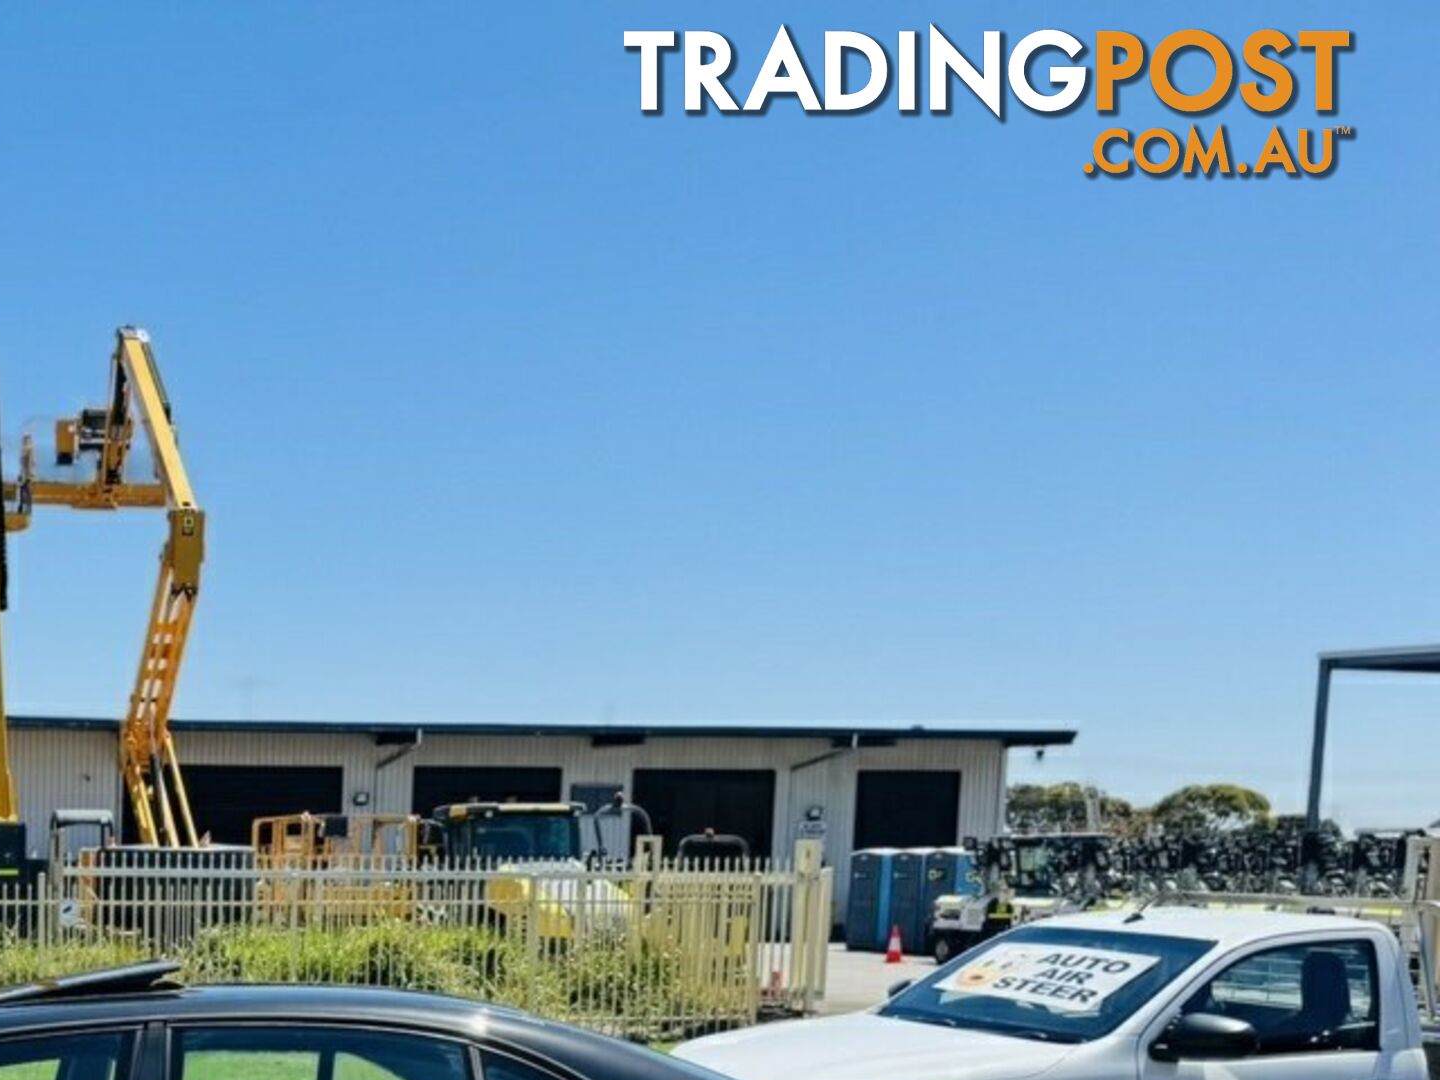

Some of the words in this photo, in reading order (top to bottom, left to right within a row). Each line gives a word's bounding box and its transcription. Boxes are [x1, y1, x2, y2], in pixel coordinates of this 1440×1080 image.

[1037, 952, 1131, 974] AUTO
[1034, 967, 1095, 986] AIR
[992, 976, 1098, 1003] STEER
